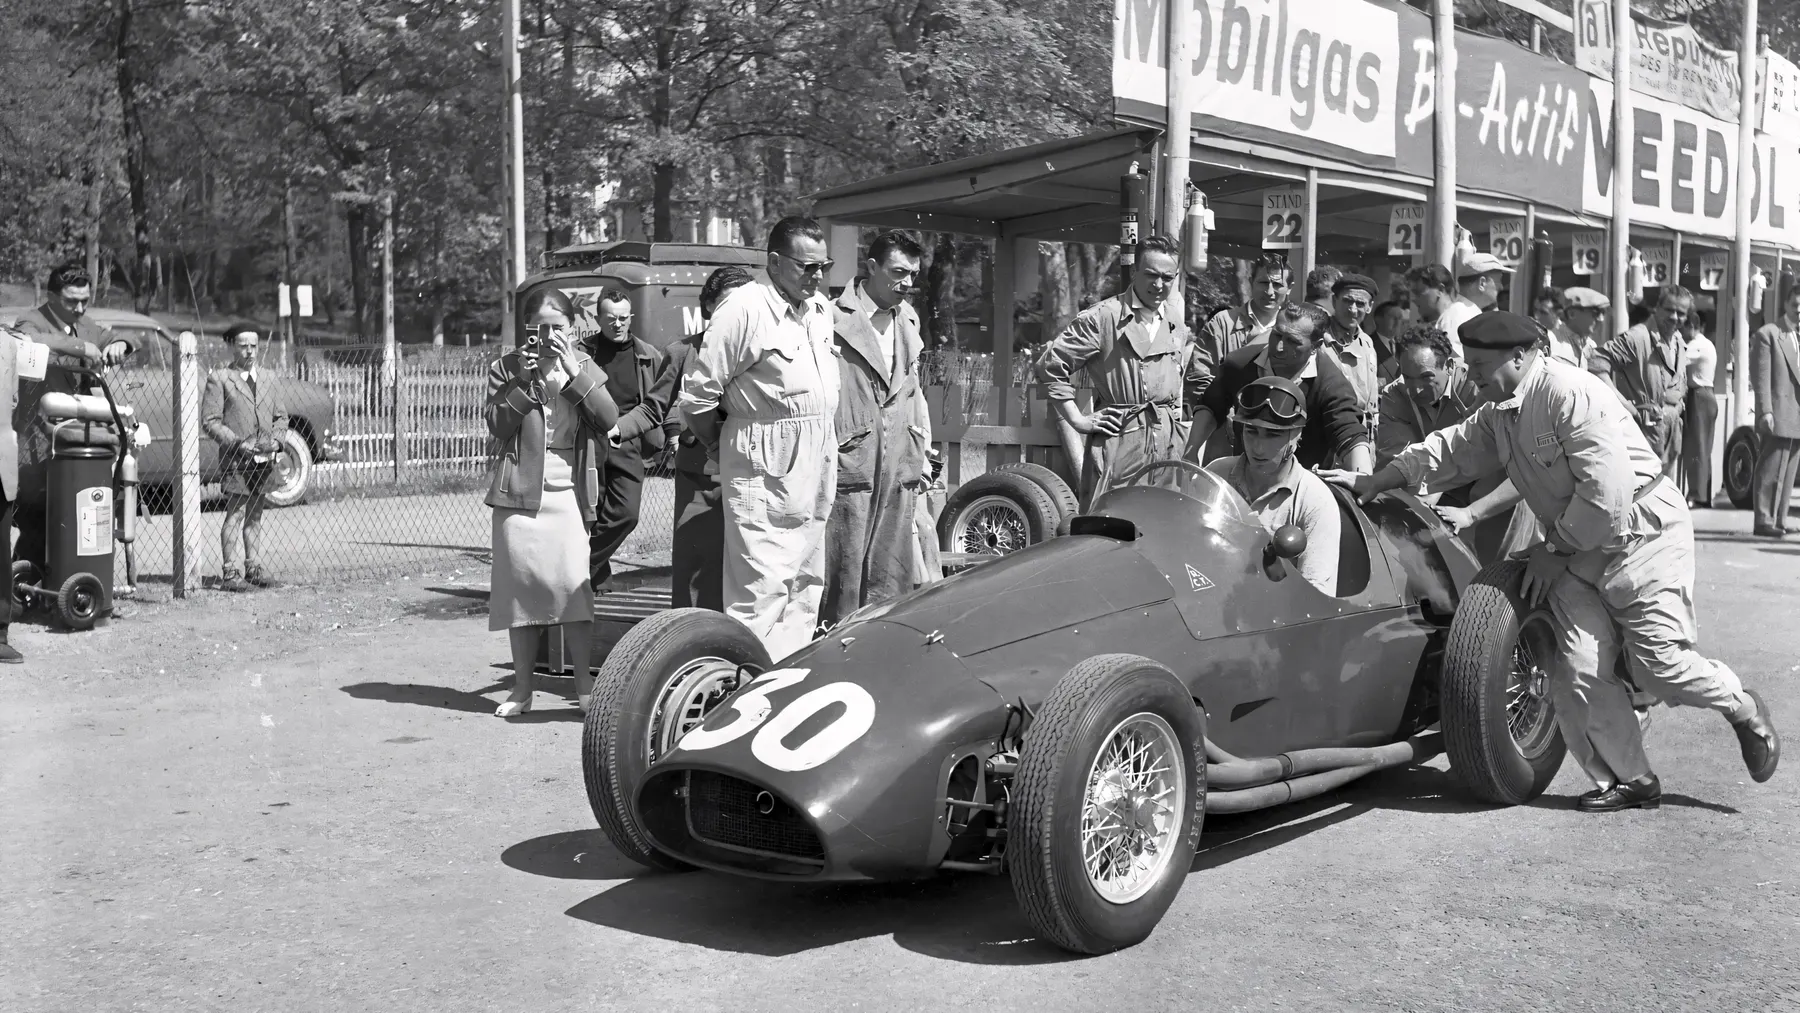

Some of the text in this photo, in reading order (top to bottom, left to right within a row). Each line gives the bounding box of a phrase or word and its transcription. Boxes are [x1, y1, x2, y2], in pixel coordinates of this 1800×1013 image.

[1404, 38, 1579, 166] B-Actif
[1267, 194, 1302, 209] STAND
[1394, 206, 1424, 220] STAND
[1266, 213, 1303, 243] 22
[1394, 223, 1423, 250] 21
[1492, 221, 1521, 234] STAND
[1493, 237, 1522, 260] 20
[1576, 248, 1600, 270] 19
[1704, 268, 1724, 286] 17
[678, 667, 876, 772] 30
